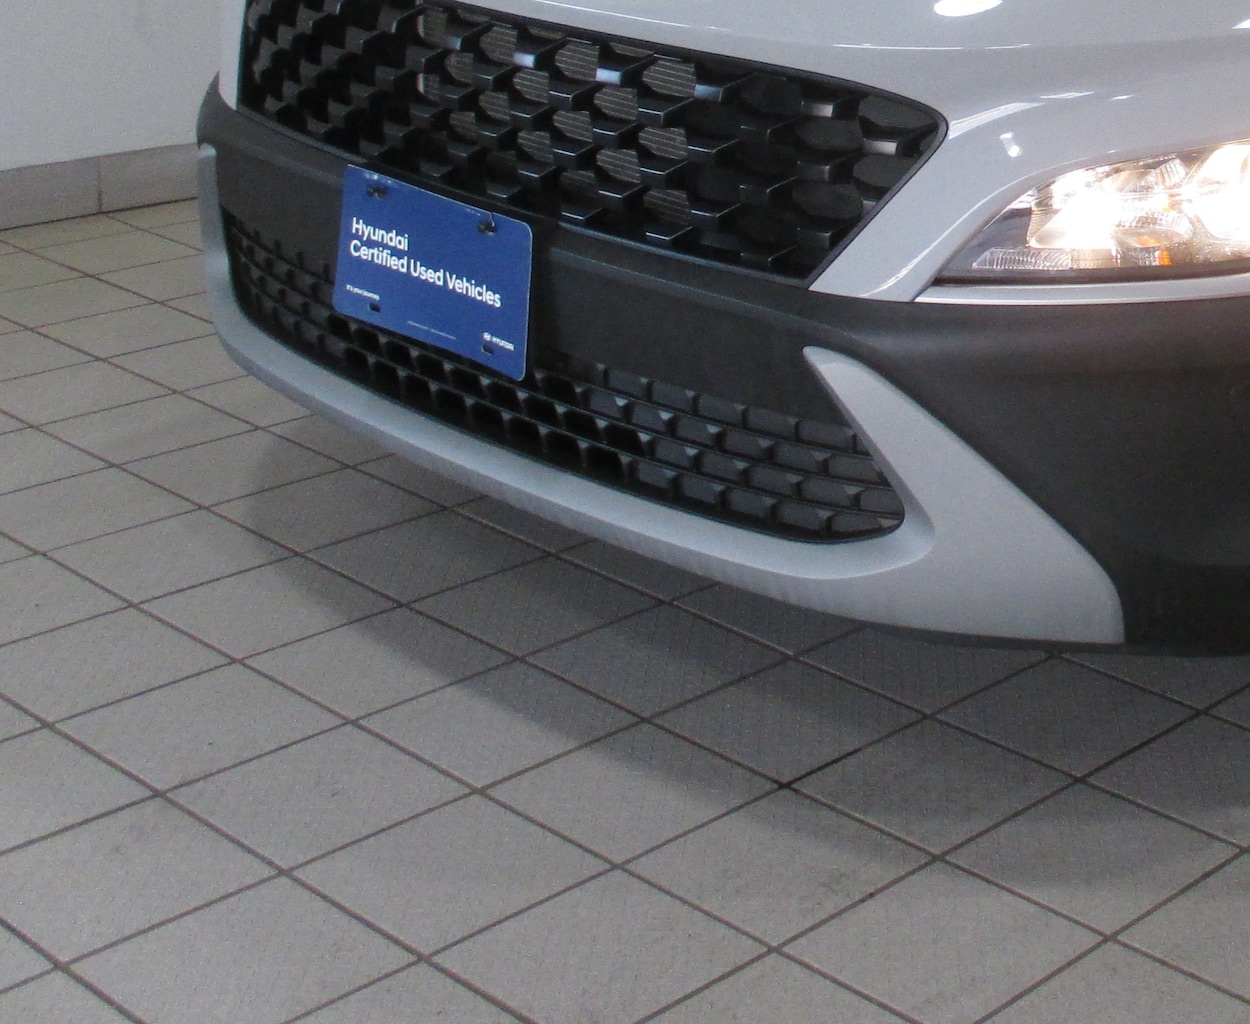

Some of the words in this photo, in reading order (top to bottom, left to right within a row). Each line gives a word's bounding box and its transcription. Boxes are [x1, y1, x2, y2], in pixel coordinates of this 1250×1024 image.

[352, 216, 409, 251] Hyundai
[350, 239, 408, 274] Certified
[410, 258, 444, 287] Used
[445, 271, 502, 309] Vehicles
